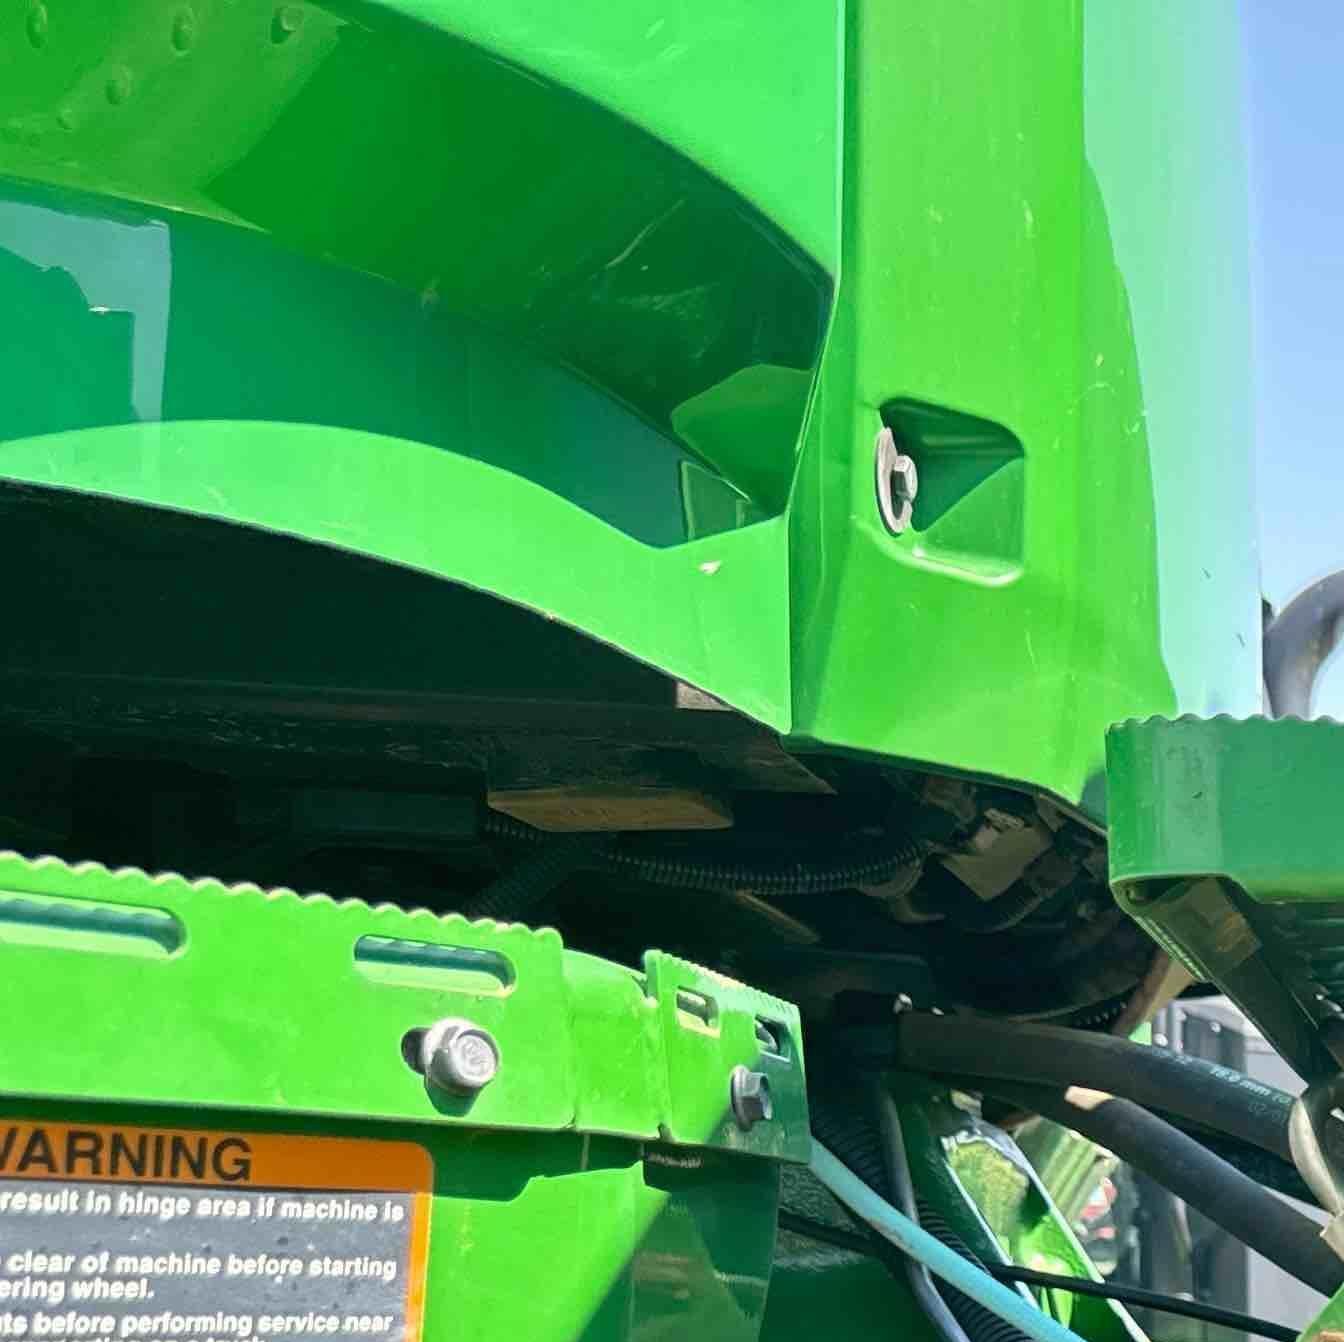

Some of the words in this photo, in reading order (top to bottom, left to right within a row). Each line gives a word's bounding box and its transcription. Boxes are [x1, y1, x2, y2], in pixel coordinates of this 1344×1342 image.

[0, 1190, 79, 1212] result
[85, 1191, 112, 1214] in
[119, 1192, 191, 1221] hinge
[197, 1197, 250, 1217] area
[257, 1197, 275, 1218] if
[280, 1198, 377, 1220] machine
[383, 1200, 404, 1222] is
[7, 1250, 76, 1273] clear
[80, 1251, 110, 1273] of
[115, 1252, 221, 1276] machine
[227, 1254, 303, 1276] before
[309, 1256, 397, 1281] starting
[71, 1277, 155, 1299] wheel.
[0, 1311, 28, 1334] ts
[34, 1311, 116, 1335] before
[121, 1311, 252, 1337] performing
[258, 1312, 339, 1333] service
[345, 1314, 393, 1332] near
